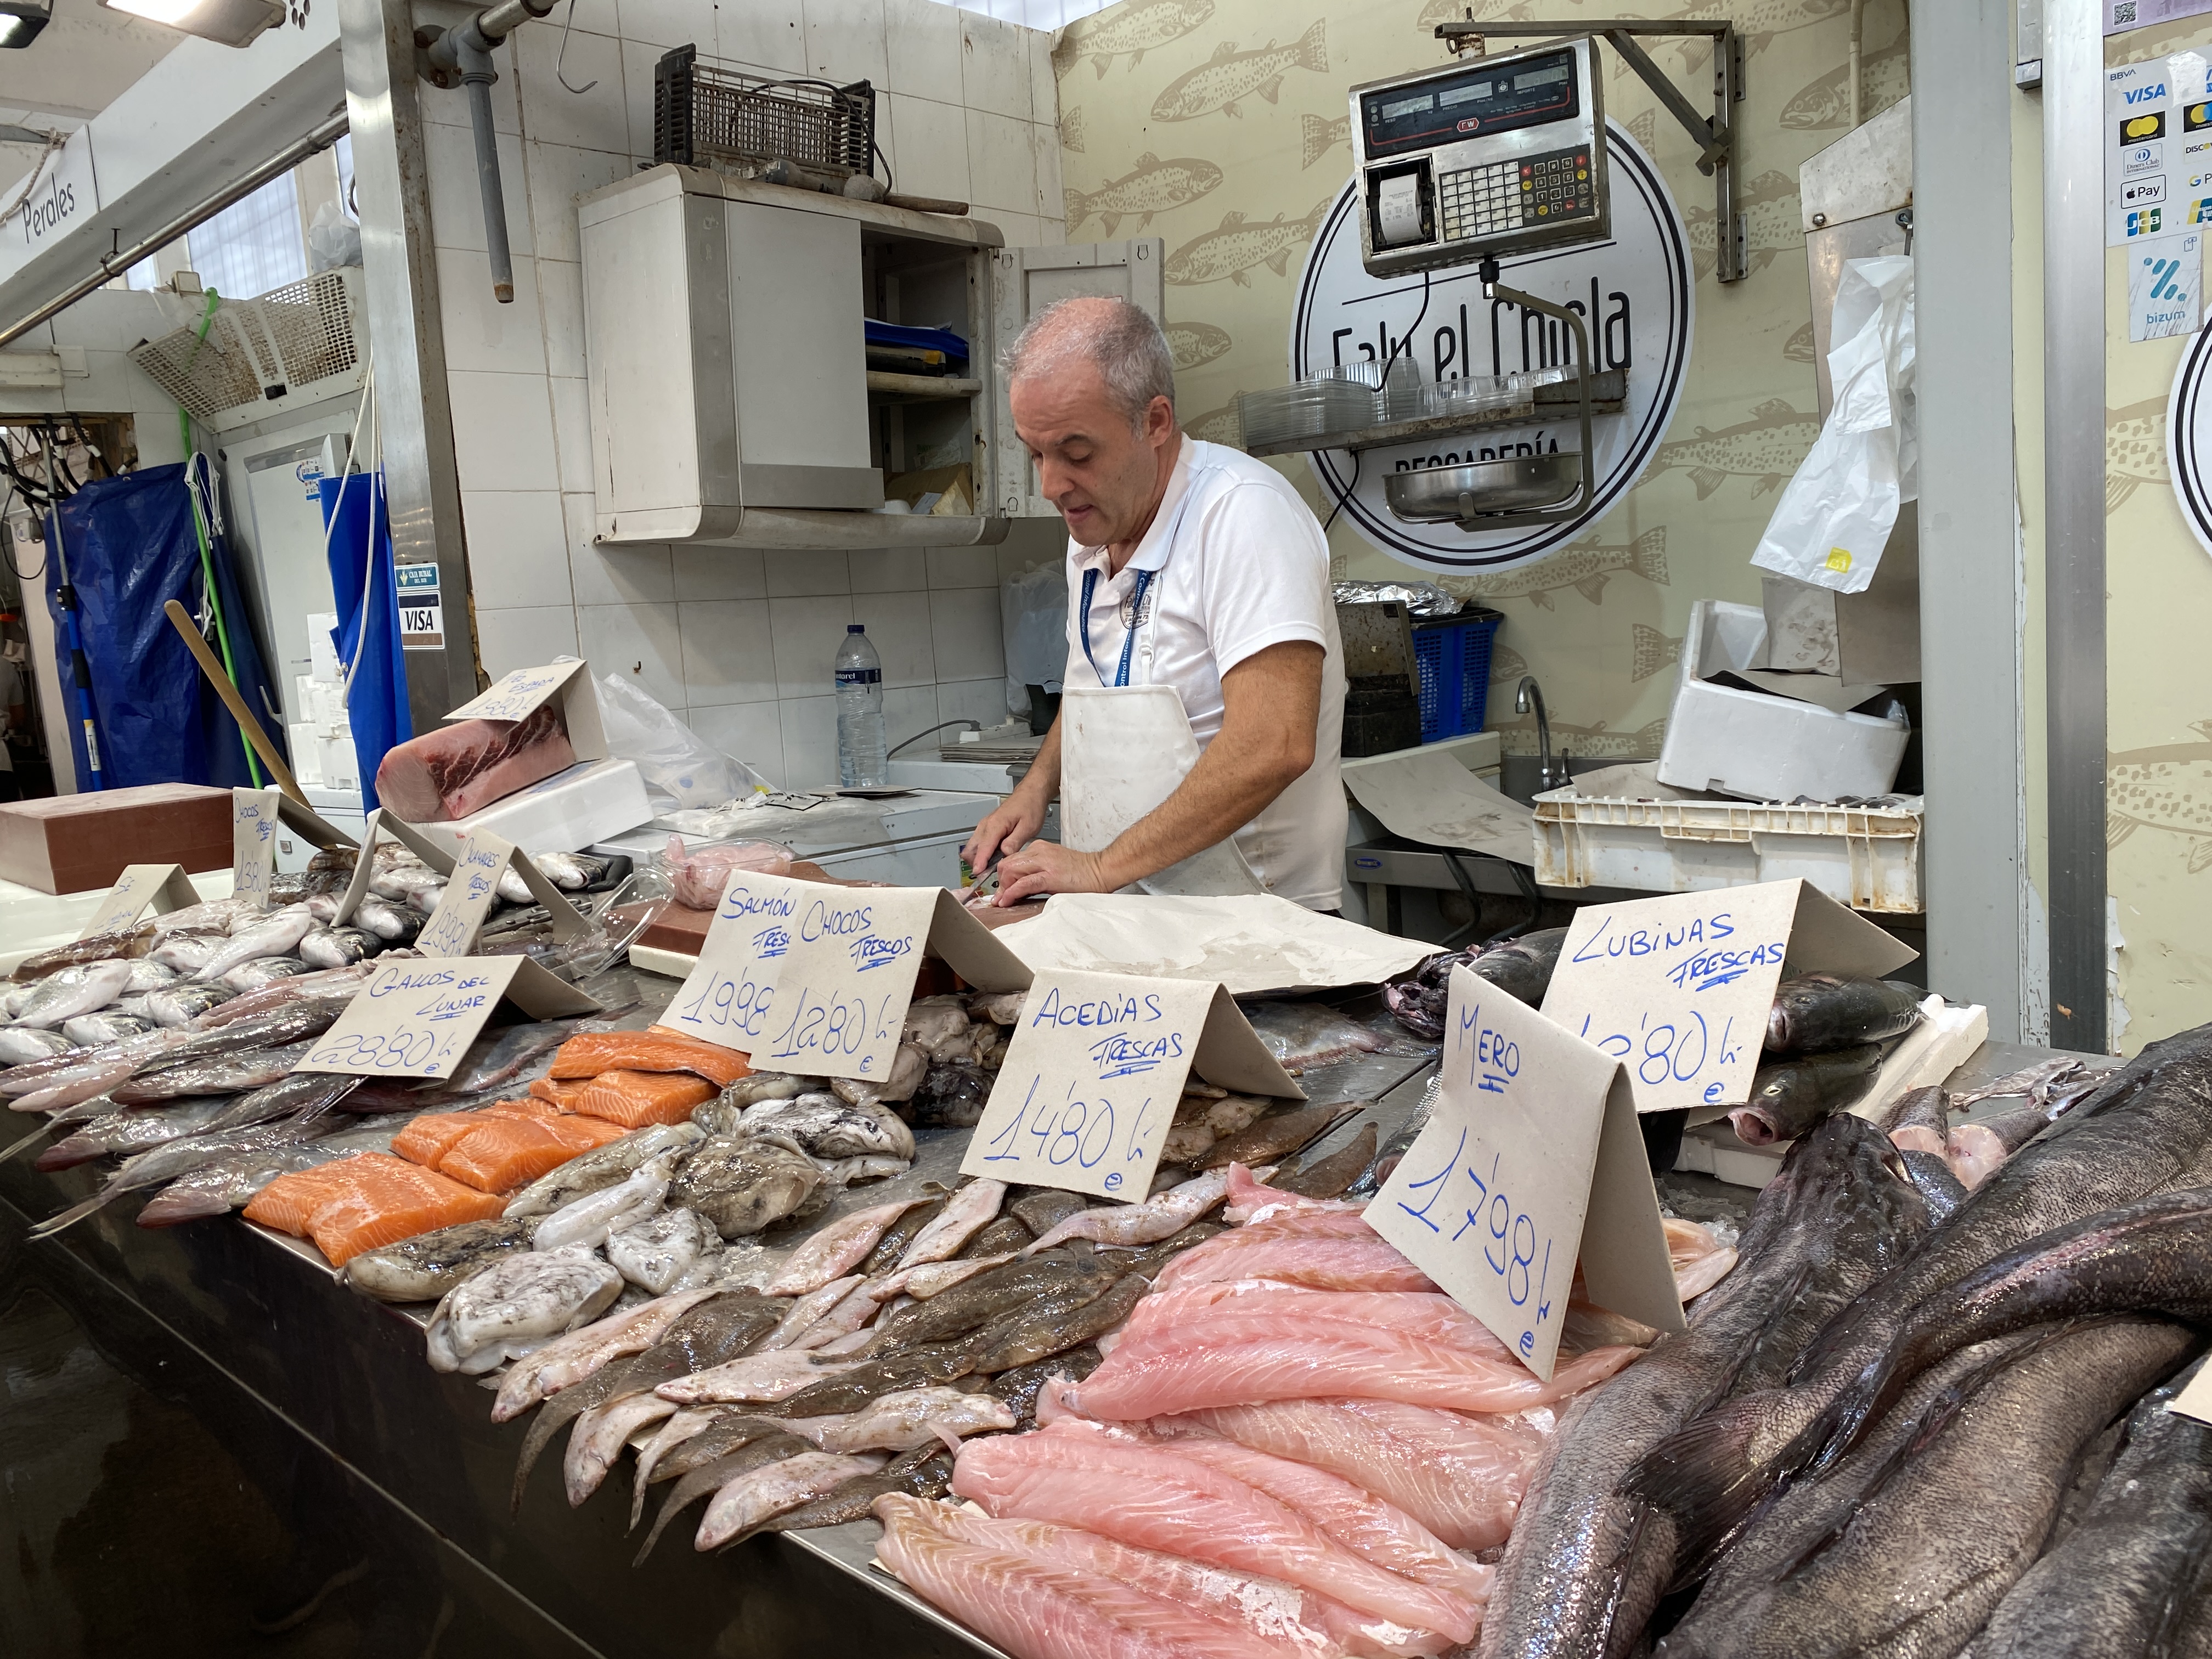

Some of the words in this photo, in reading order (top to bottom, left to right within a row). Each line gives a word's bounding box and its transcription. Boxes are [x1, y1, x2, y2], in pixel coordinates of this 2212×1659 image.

[2110, 69, 2136, 81] BBVA
[2122, 83, 2166, 105] VISA
[2128, 133, 2158, 144] mastercard
[2126, 161, 2145, 170] Diners
[2137, 185, 2160, 198] Pay
[22, 172, 75, 244] Perales
[2147, 311, 2185, 324] bizum
[1434, 303, 1470, 382] el
[405, 610, 434, 631] VISA
[508, 676, 555, 693] ESPADA
[235, 797, 259, 823] CHOCOS
[721, 888, 797, 919] SALMÓN
[801, 900, 873, 943] CHOCOS
[849, 934, 913, 966] FRESCOS
[1666, 943, 1785, 989] FRESCAS
[370, 967, 456, 997] GALLOS
[458, 977, 490, 989] DEL
[416, 994, 486, 1016] LUNAR
[1088, 1032, 1183, 1069] FRESCAS
[1458, 1003, 1520, 1086] MERO
